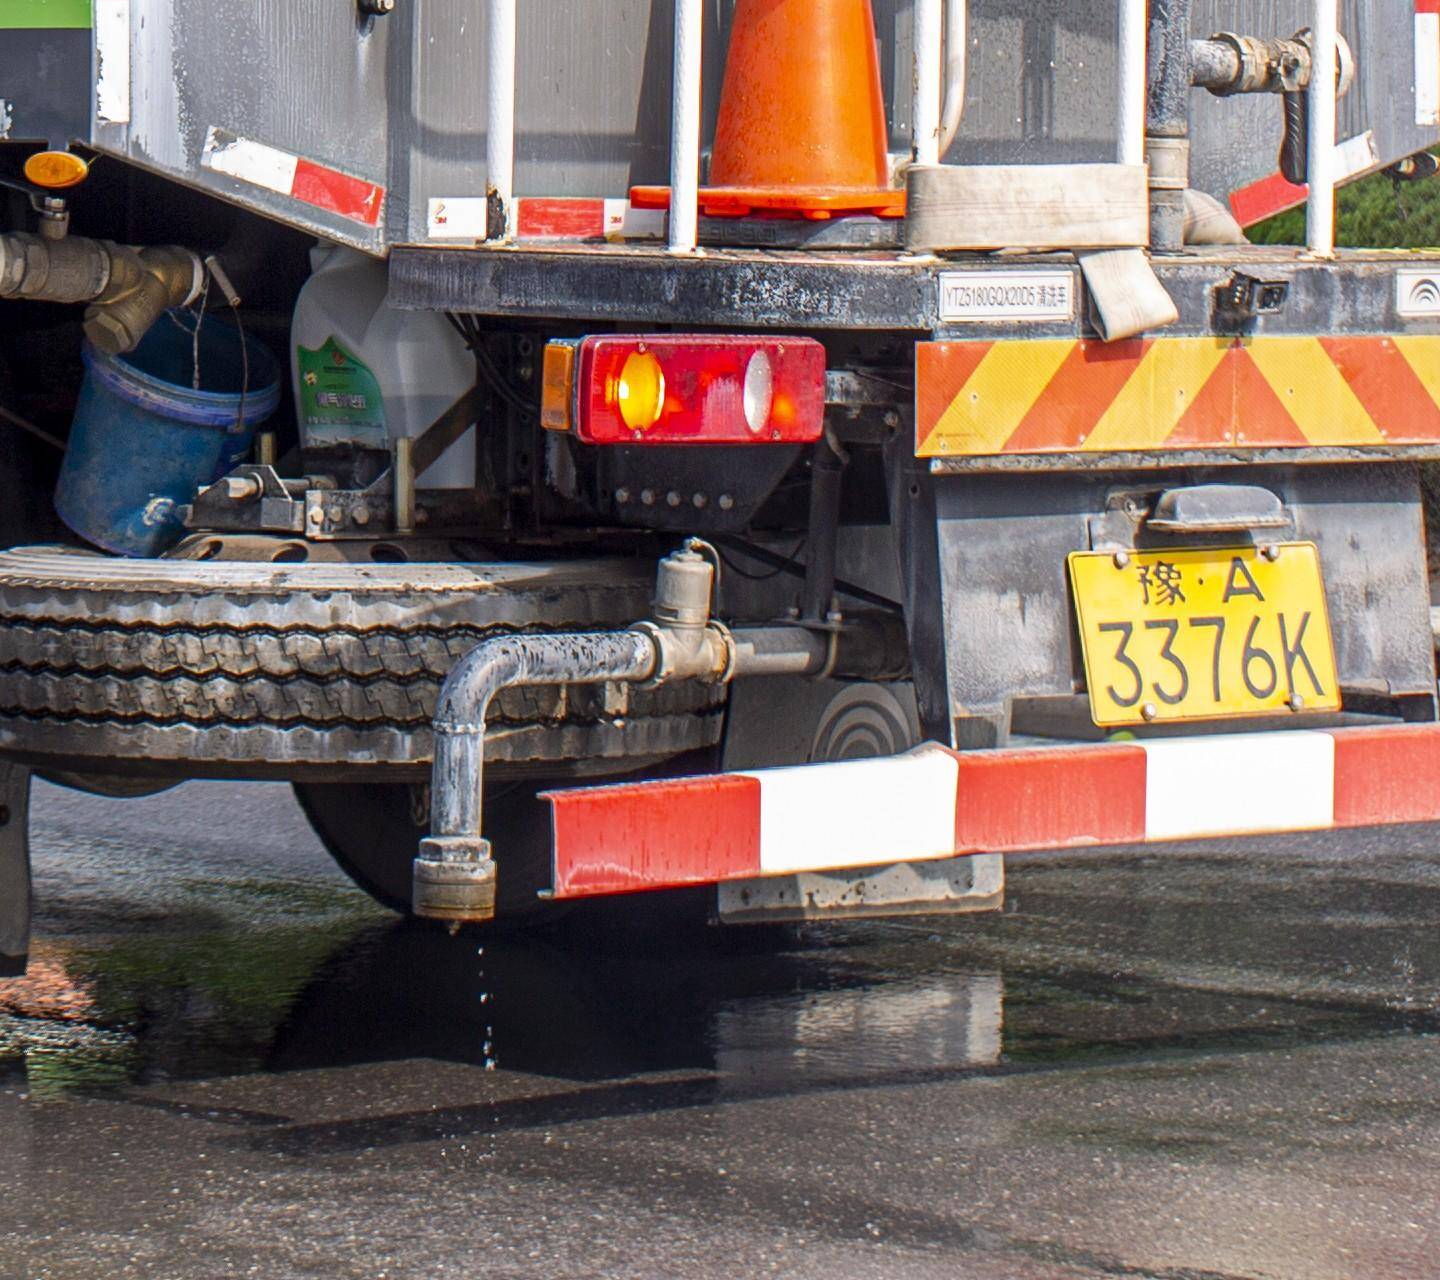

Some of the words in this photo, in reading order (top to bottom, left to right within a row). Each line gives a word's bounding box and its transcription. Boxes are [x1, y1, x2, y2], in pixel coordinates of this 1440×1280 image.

[434, 216, 447, 225] 3M
[610, 216, 622, 225] 3M
[1098, 610, 1326, 709] 3376K
